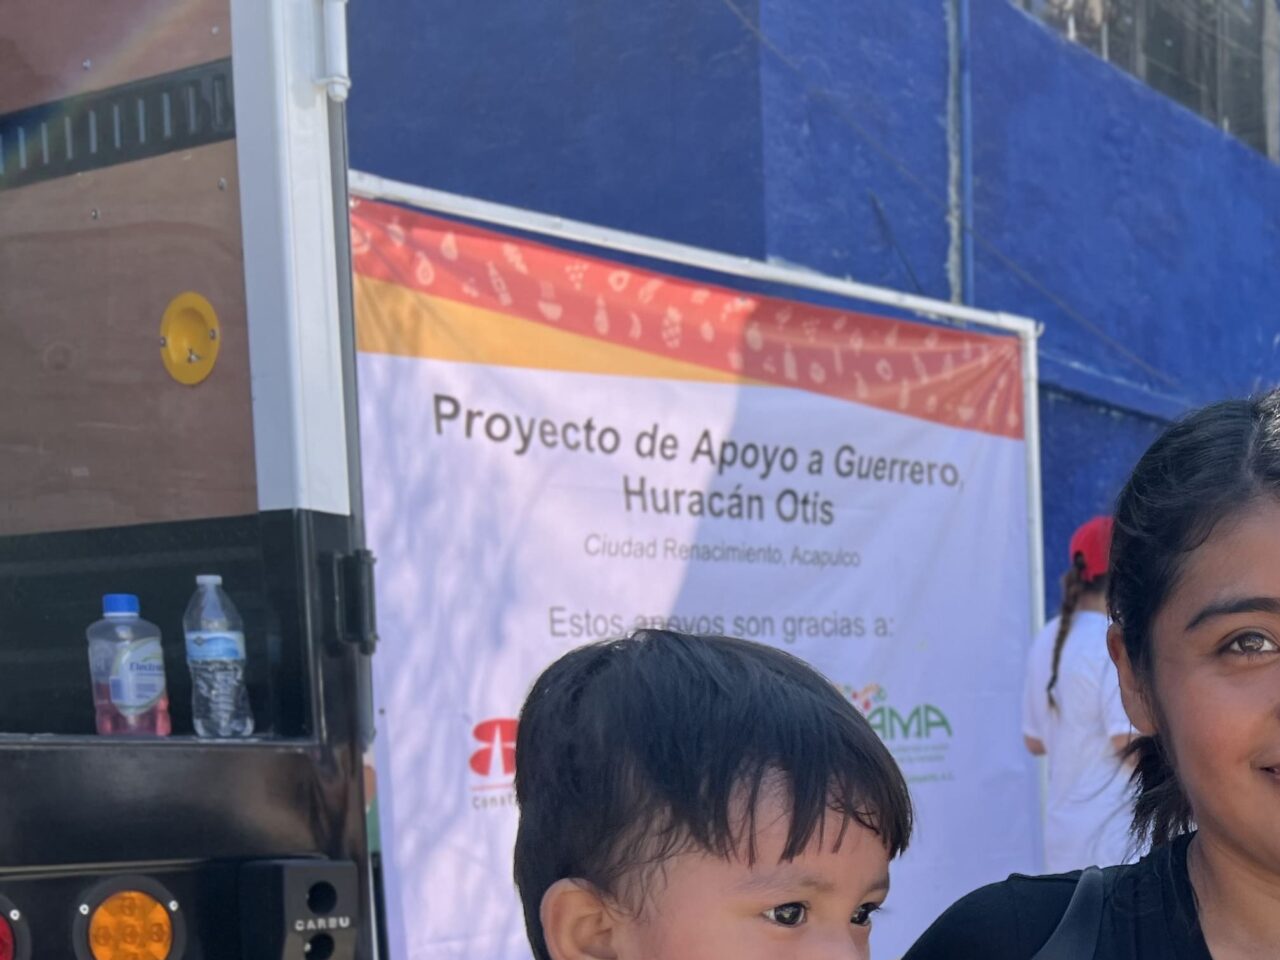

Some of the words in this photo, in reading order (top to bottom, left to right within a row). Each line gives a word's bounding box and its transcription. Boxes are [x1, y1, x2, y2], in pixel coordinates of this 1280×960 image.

[433, 393, 621, 456] Proyecto
[635, 422, 679, 461] de
[690, 429, 798, 480] Apoyo
[807, 448, 825, 476] a
[622, 474, 765, 521] Huracán
[775, 488, 836, 527] Otis
[584, 532, 657, 560] Ciudad
[790, 546, 862, 570] Acapulco
[548, 605, 624, 638] Estos
[733, 615, 775, 638] son
[783, 611, 866, 645] gracias
[867, 703, 953, 740] AMA
